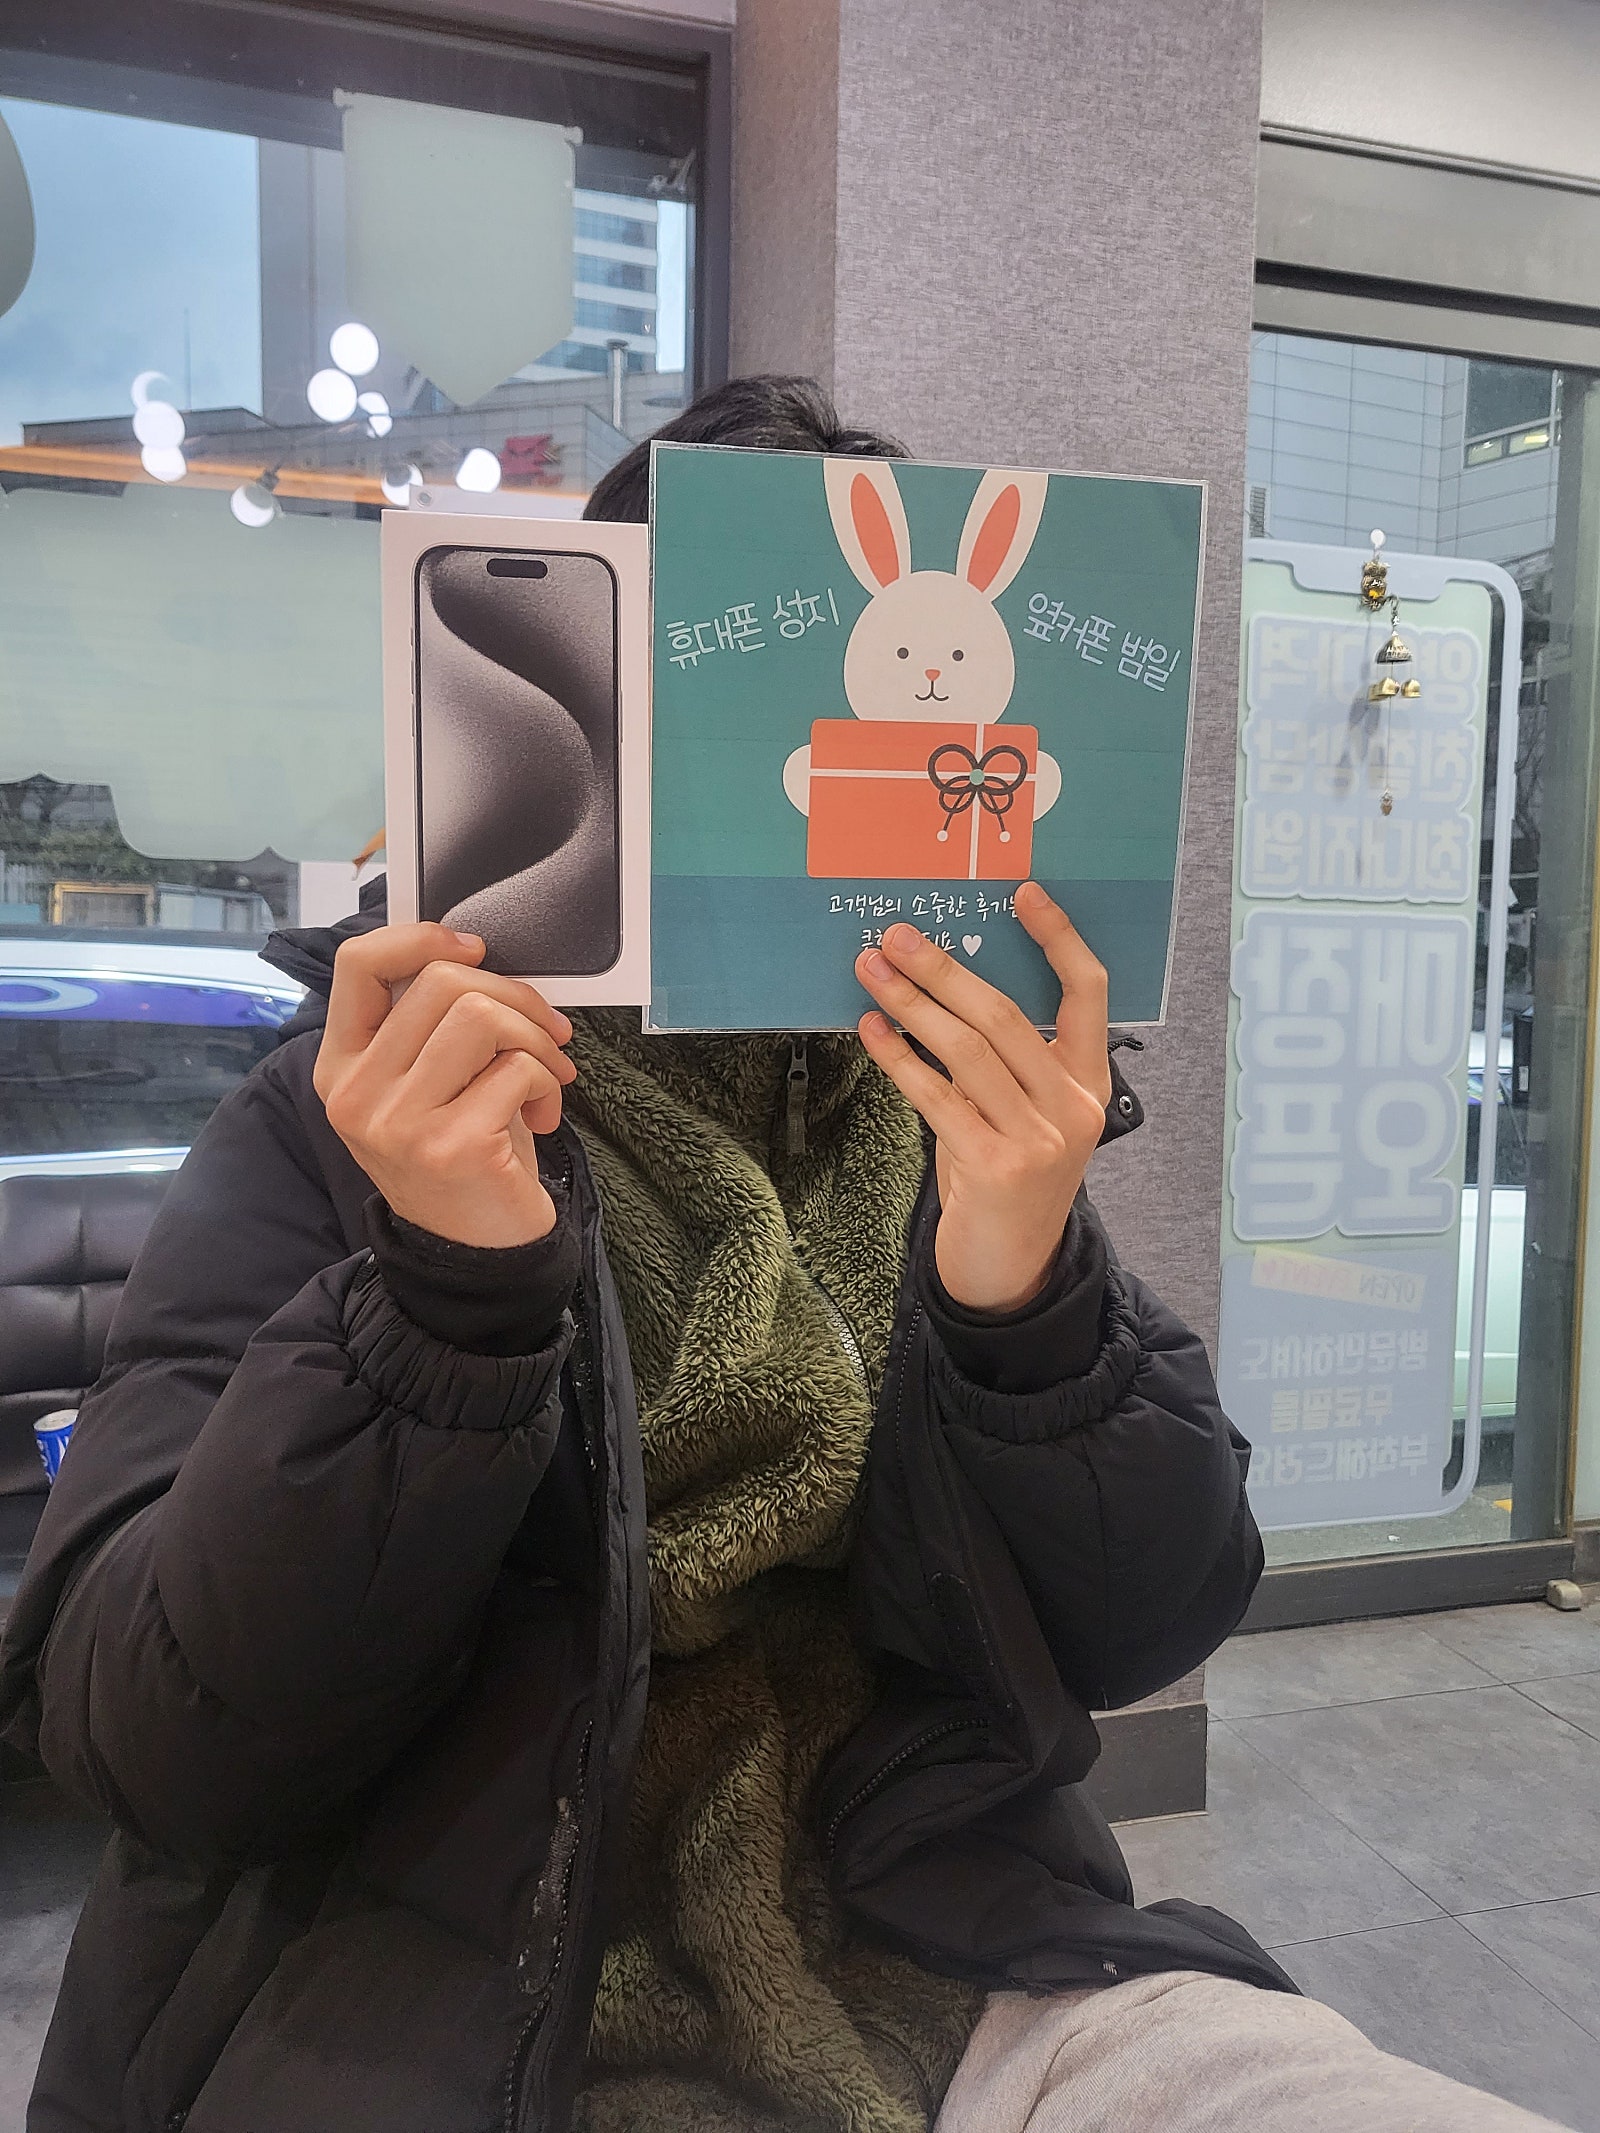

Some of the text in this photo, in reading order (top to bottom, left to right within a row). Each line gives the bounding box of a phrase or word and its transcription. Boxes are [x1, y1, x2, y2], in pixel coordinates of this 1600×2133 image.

[666, 587, 840, 671] 휴대폰 성지
[1023, 592, 1182, 692] 옆커폰 범일
[829, 894, 901, 919] 고객님의
[912, 891, 968, 924] 소중한
